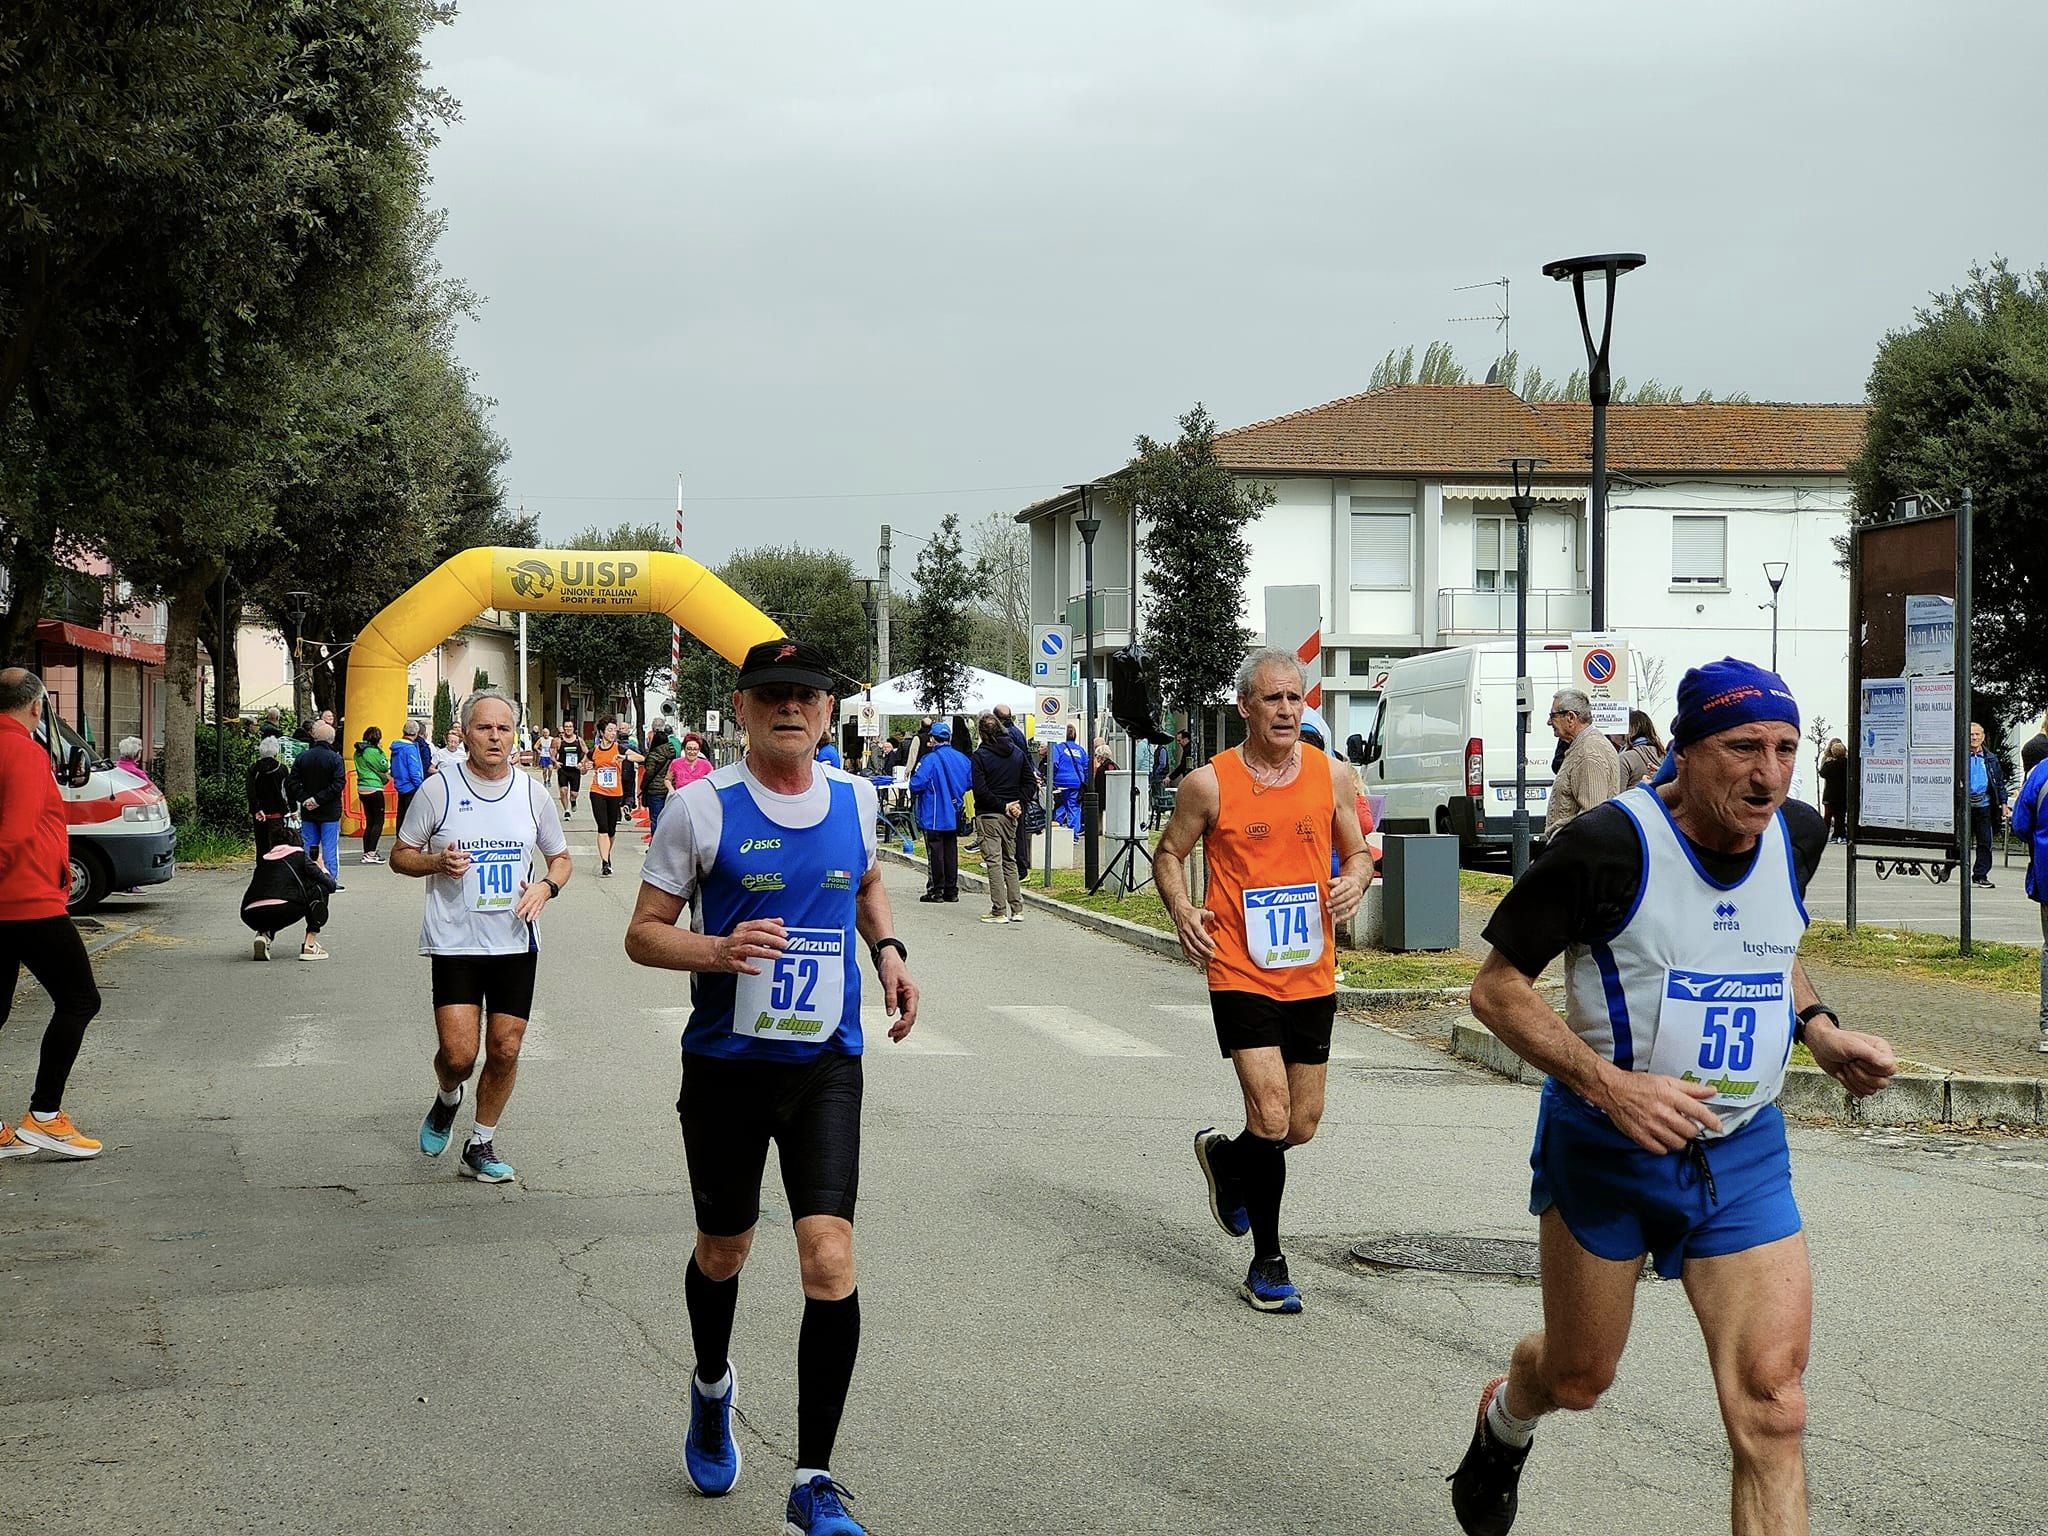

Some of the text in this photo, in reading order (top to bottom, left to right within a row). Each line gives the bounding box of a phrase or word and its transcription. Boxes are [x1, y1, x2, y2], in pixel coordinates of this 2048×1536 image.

[560, 561, 638, 587] UISP
[560, 588, 638, 597] UNIONE ITALIANA
[1909, 622, 1952, 645] Ivan Alvisi
[1931, 702, 1952, 711] NATALIA
[1866, 772, 1904, 785] ALVISI IVAN
[1929, 776, 1952, 785] ANSELMO
[754, 838, 781, 850] asics
[476, 864, 512, 895] 140
[756, 873, 782, 882] BCC
[1265, 906, 1309, 947] 174
[771, 958, 819, 1012] 52
[1697, 1006, 1757, 1071] 53
